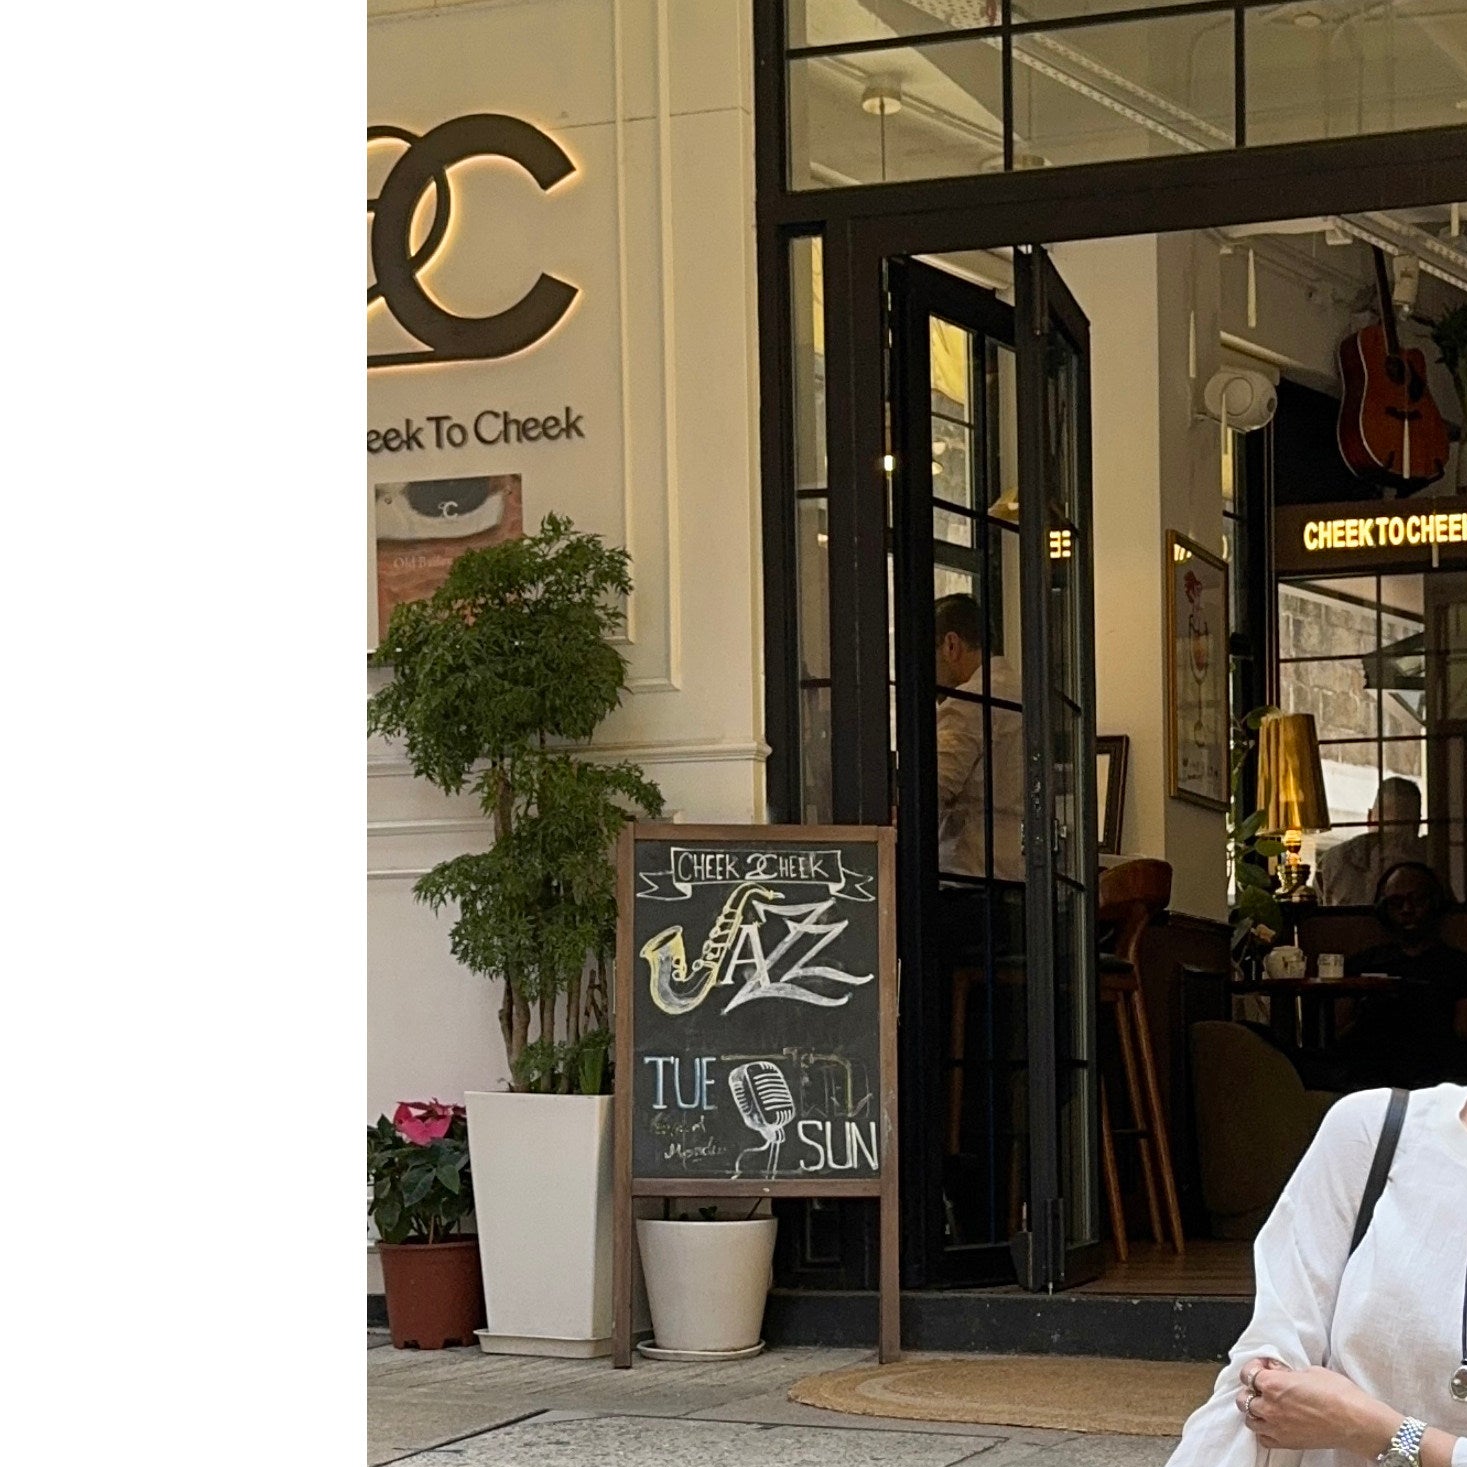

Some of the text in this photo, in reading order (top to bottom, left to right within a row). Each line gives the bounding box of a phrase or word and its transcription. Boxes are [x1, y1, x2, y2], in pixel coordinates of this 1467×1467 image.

[426, 415, 468, 449] To
[474, 406, 584, 445] Cheek
[1303, 518, 1375, 551] CHEEK
[1375, 516, 1405, 546] TO
[678, 851, 740, 881] CHEEK
[643, 1055, 718, 1111] TUE
[798, 1119, 879, 1171] SUN
